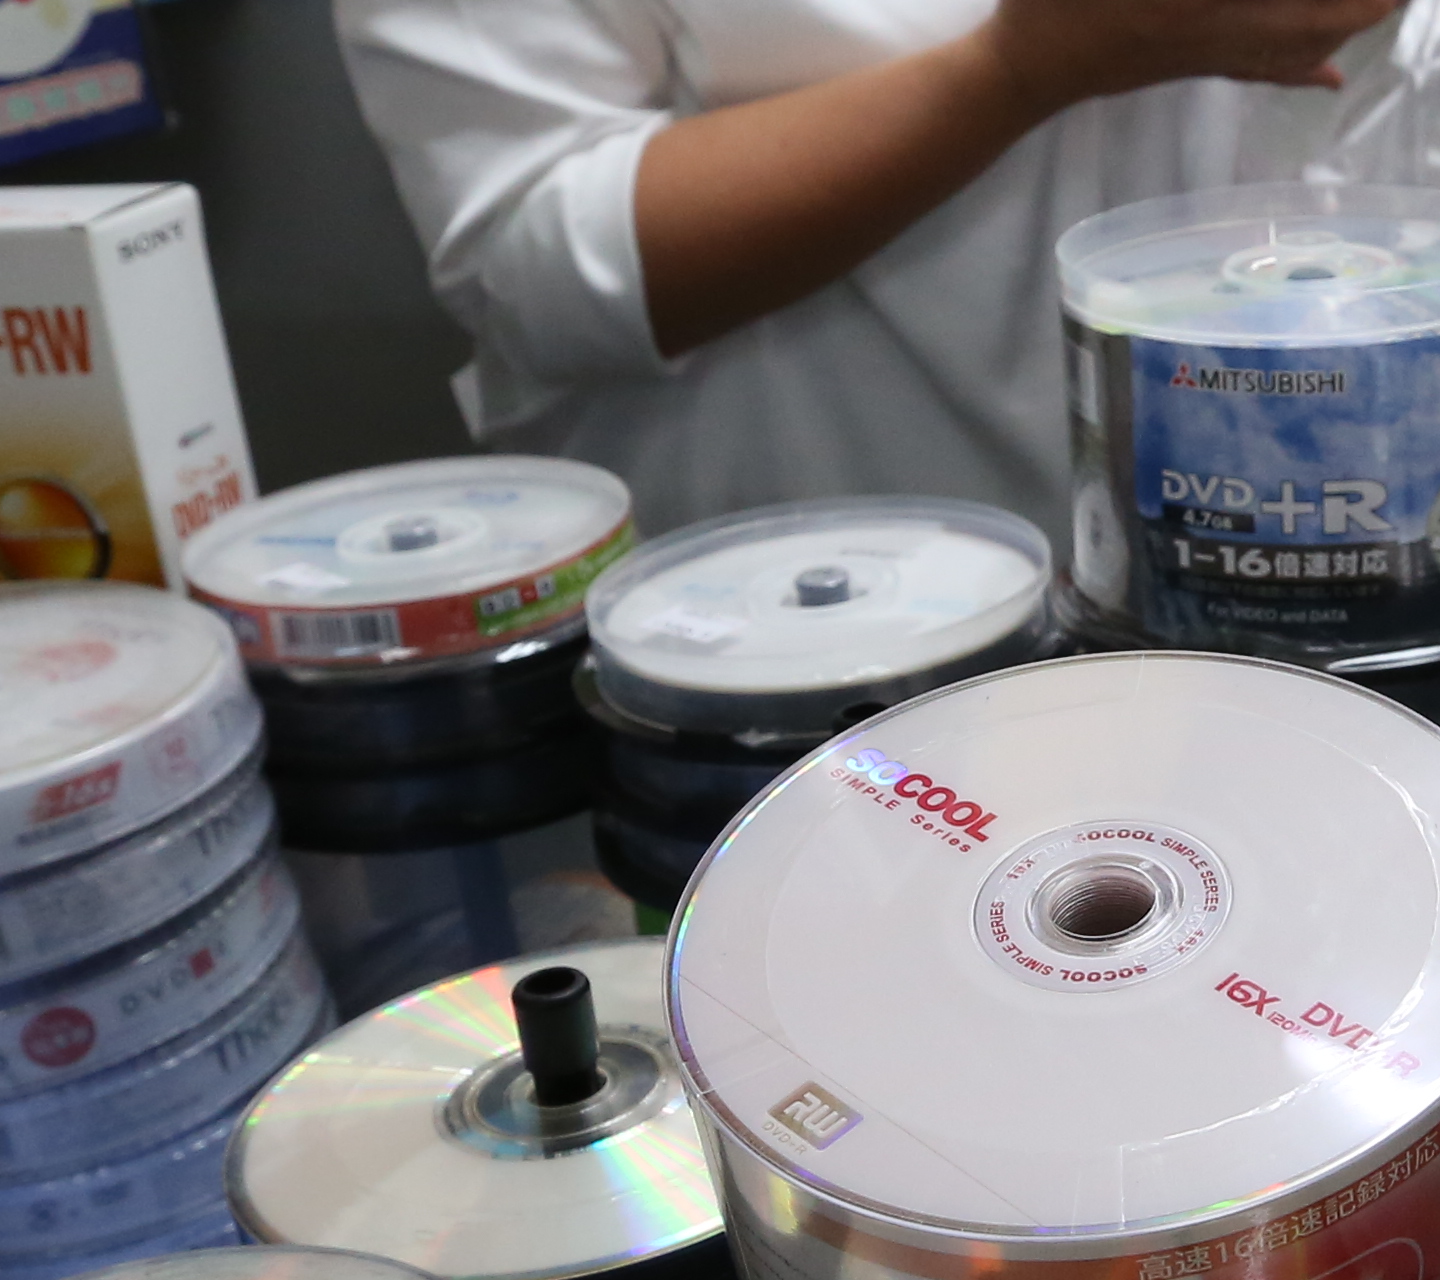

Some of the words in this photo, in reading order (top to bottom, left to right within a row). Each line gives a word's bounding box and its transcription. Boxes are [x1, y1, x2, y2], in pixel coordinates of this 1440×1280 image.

[117, 220, 186, 263] SONY
[1199, 367, 1345, 396] MITSUBISHI
[830, 767, 902, 811] SIMPLE
[909, 813, 973, 853] Series
[845, 747, 999, 844] SOCOOL
[1213, 971, 1282, 1018] 16X
